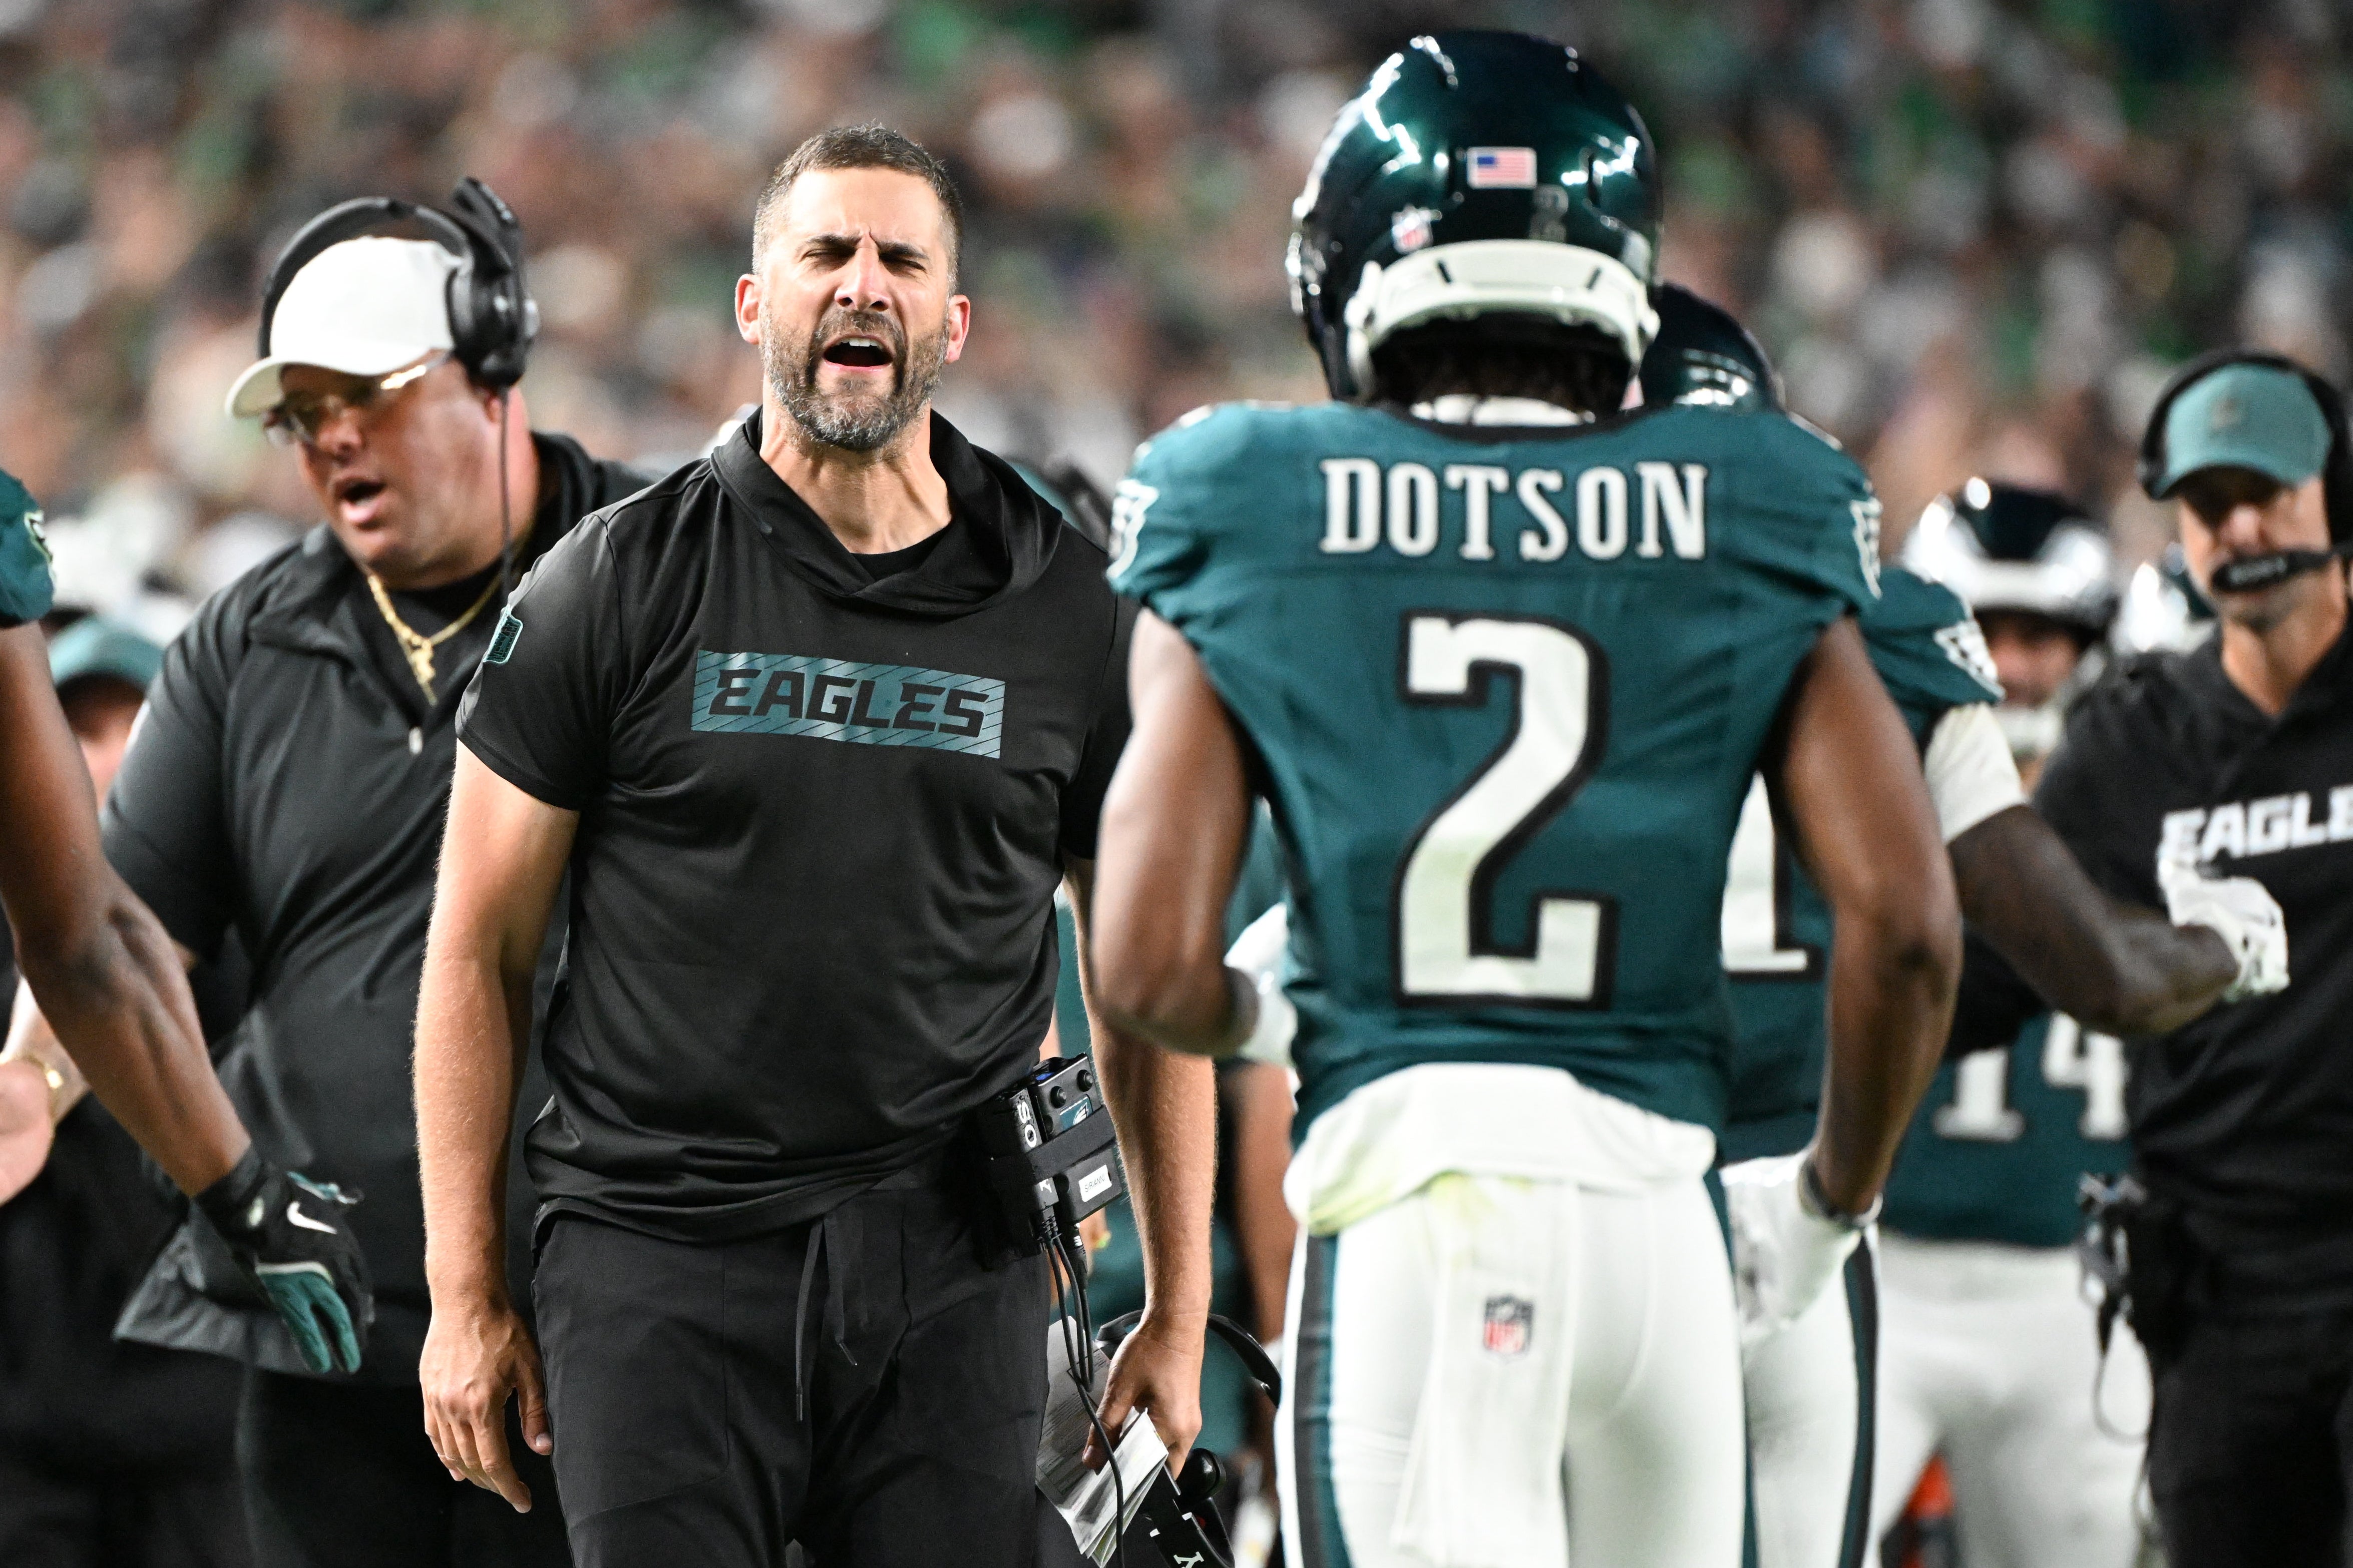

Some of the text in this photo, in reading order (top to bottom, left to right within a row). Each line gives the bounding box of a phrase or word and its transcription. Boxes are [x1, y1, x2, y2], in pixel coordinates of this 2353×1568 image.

[1318, 457, 1708, 562] DOTSON
[707, 669, 991, 738] EAGLES
[1399, 615, 1606, 1002] 2
[1933, 1010, 2132, 1142] 14
[1084, 1173, 1106, 1193] SIRIANNI
